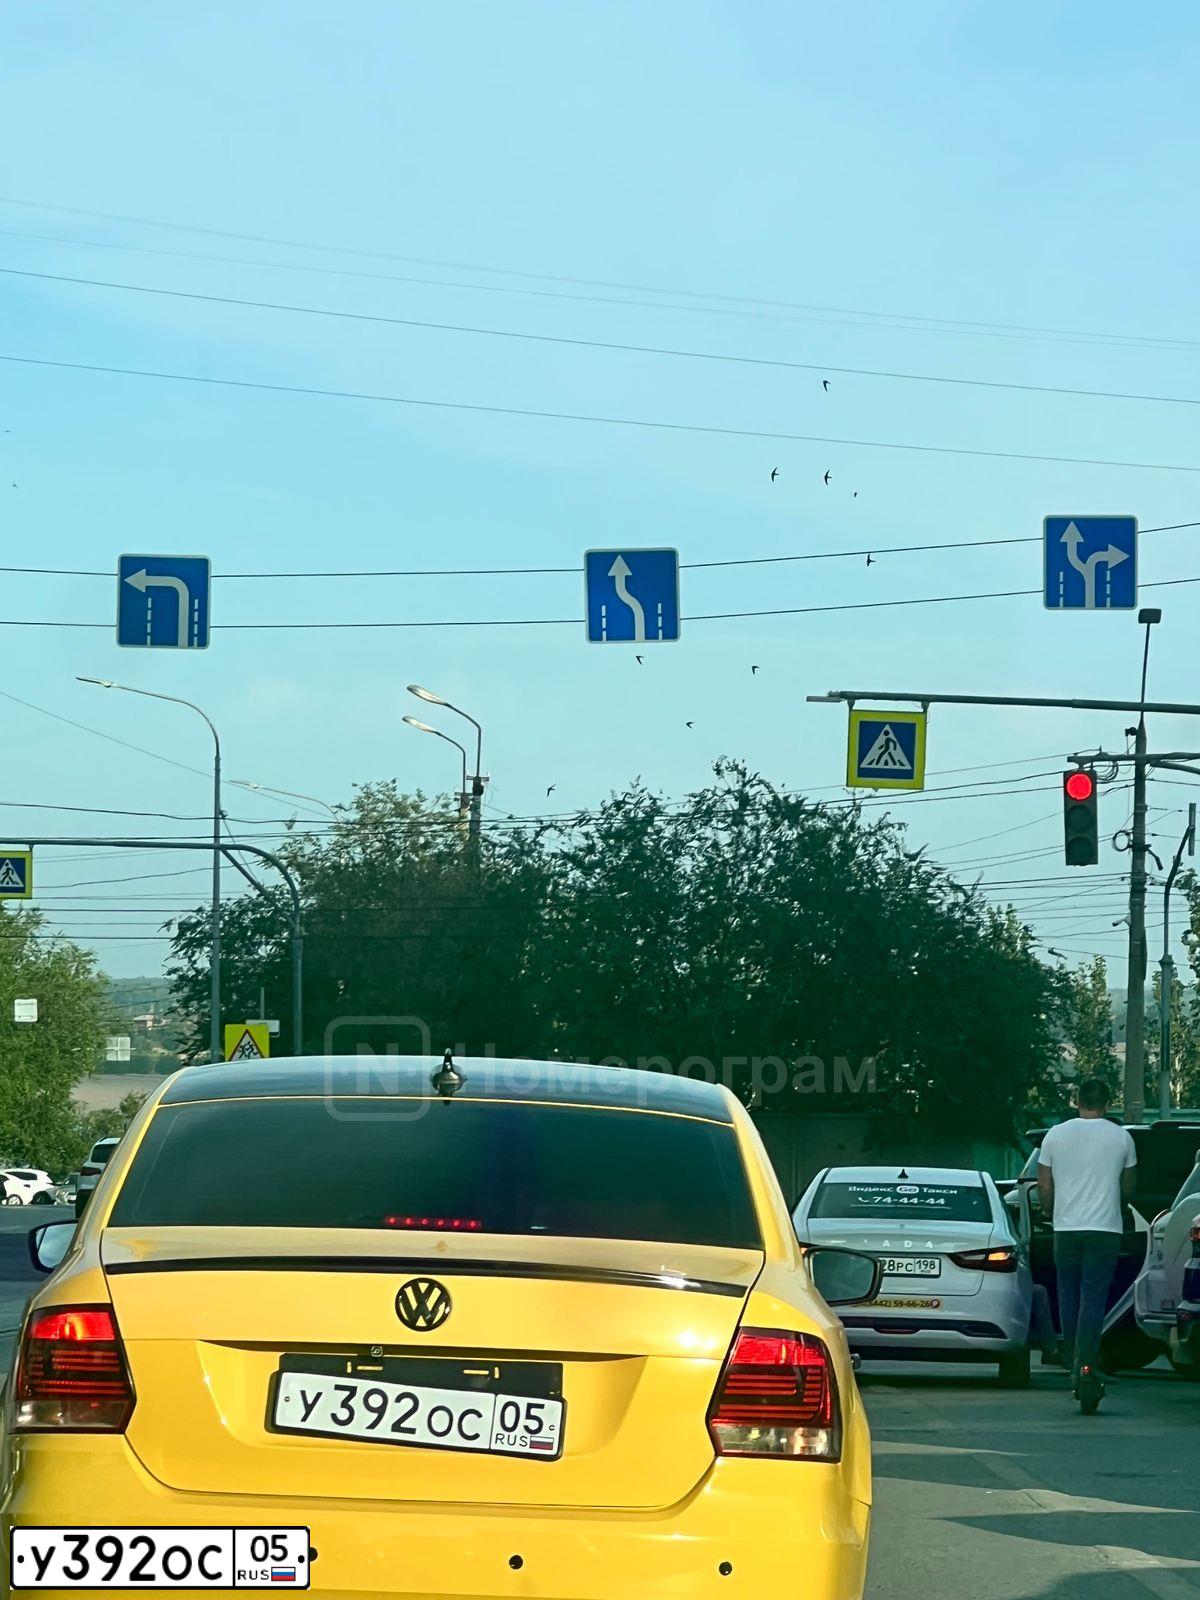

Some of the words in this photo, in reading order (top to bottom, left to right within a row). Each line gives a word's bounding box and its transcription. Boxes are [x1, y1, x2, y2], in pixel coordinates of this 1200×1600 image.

[922, 1187, 958, 1195] Такси
[873, 1196, 946, 1205] 74-44-44
[864, 1239, 934, 1249] ADA
[880, 1259, 914, 1272] 28РС
[916, 1259, 936, 1270] 198
[299, 1384, 484, 1441] У392ОС
[500, 1400, 546, 1435] 05
[494, 1433, 529, 1448] RUS
